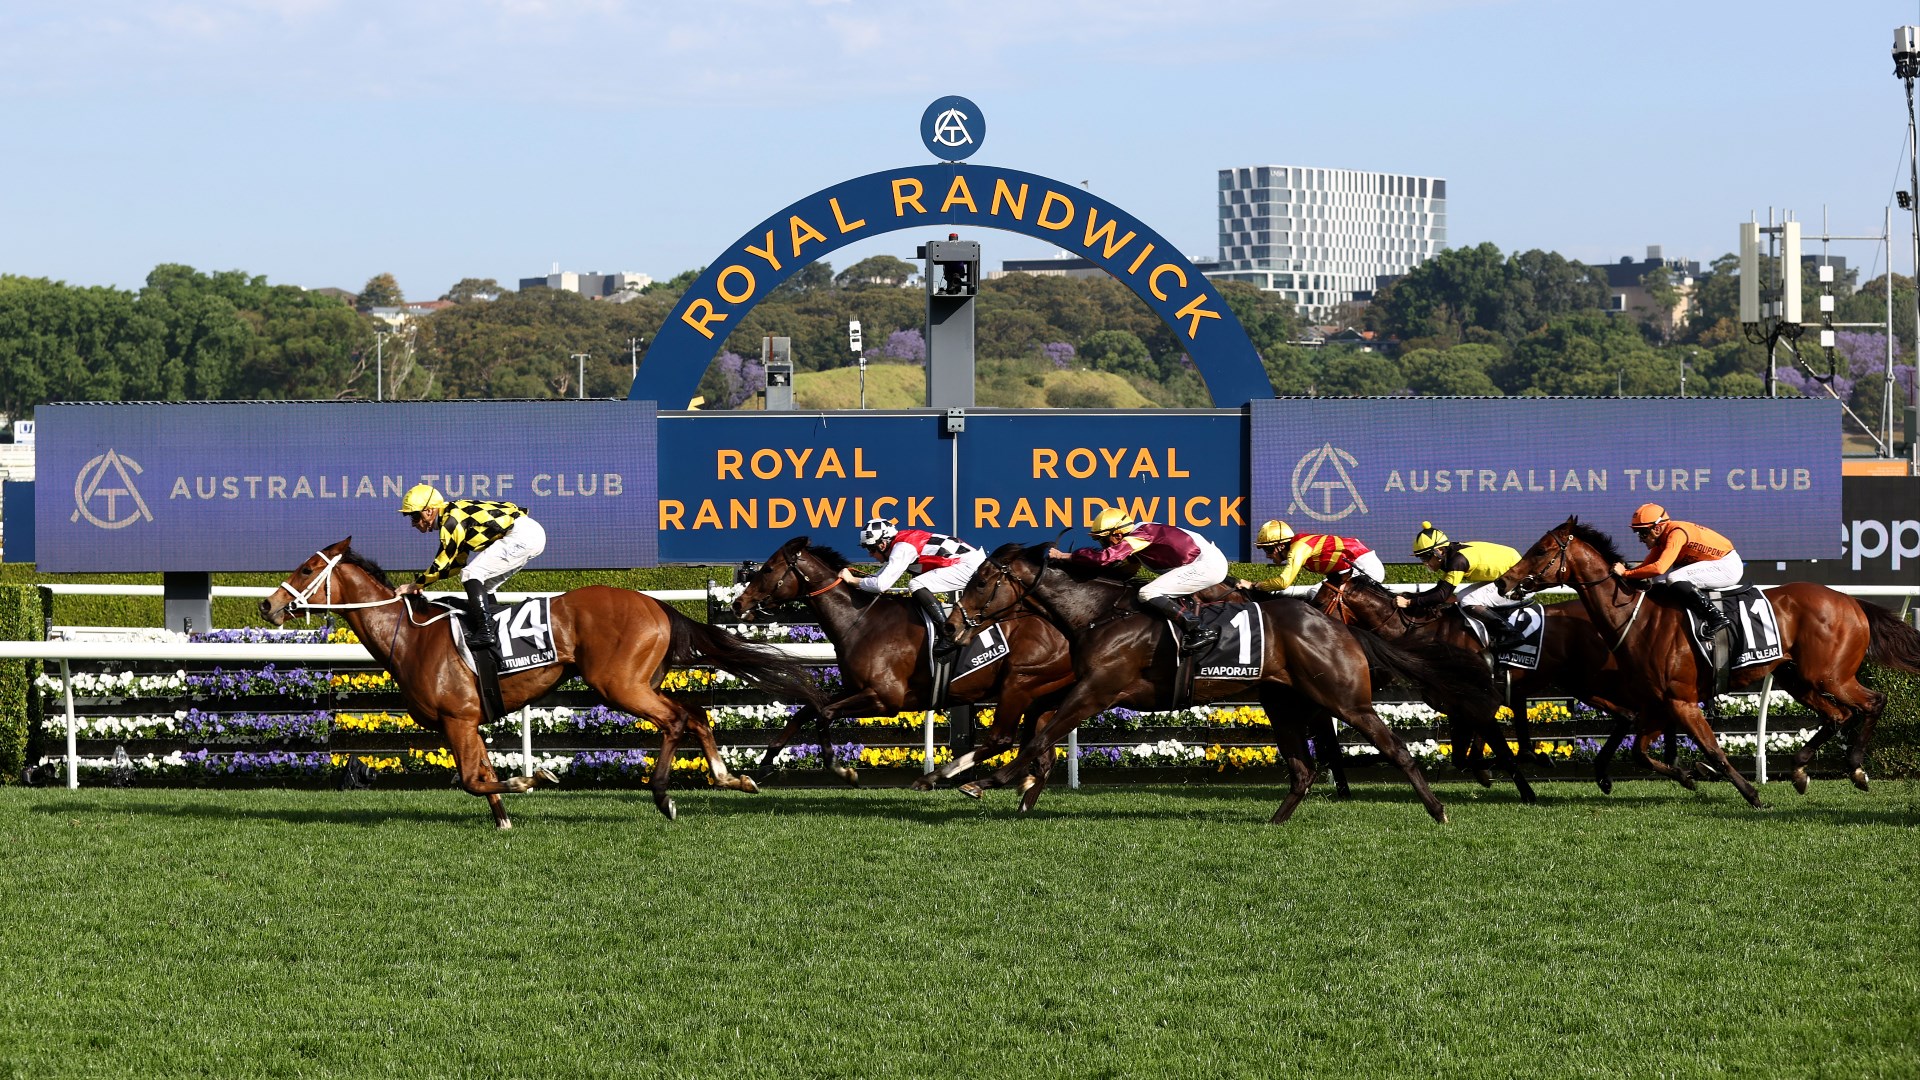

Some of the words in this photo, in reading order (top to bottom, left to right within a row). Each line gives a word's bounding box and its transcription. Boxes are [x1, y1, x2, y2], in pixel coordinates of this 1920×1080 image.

[681, 197, 866, 339] ROYAL
[891, 175, 1222, 339] RANDWICK
[717, 447, 877, 480] ROYAL
[1032, 447, 1190, 479] ROYAL
[169, 475, 403, 500] AUSTRALIAN
[421, 474, 515, 498] TURF
[531, 473, 623, 497] CLUB
[1384, 469, 1607, 493] AUSTRALIAN
[1623, 468, 1711, 492] TURF
[1726, 468, 1811, 491] CLUB
[658, 496, 936, 531] RANDWICK
[974, 496, 1247, 529] RANDWICK
[492, 599, 548, 658] 14
[1229, 609, 1252, 665] 1
[1738, 598, 1778, 649] 11
[502, 655, 531, 668] UTUMN
[531, 650, 554, 664] GLOW
[971, 644, 1006, 666] SEPALS
[1510, 652, 1537, 666] TOWER
[1756, 647, 1779, 659] CLEAR
[1200, 666, 1260, 676] EVAPORATE
